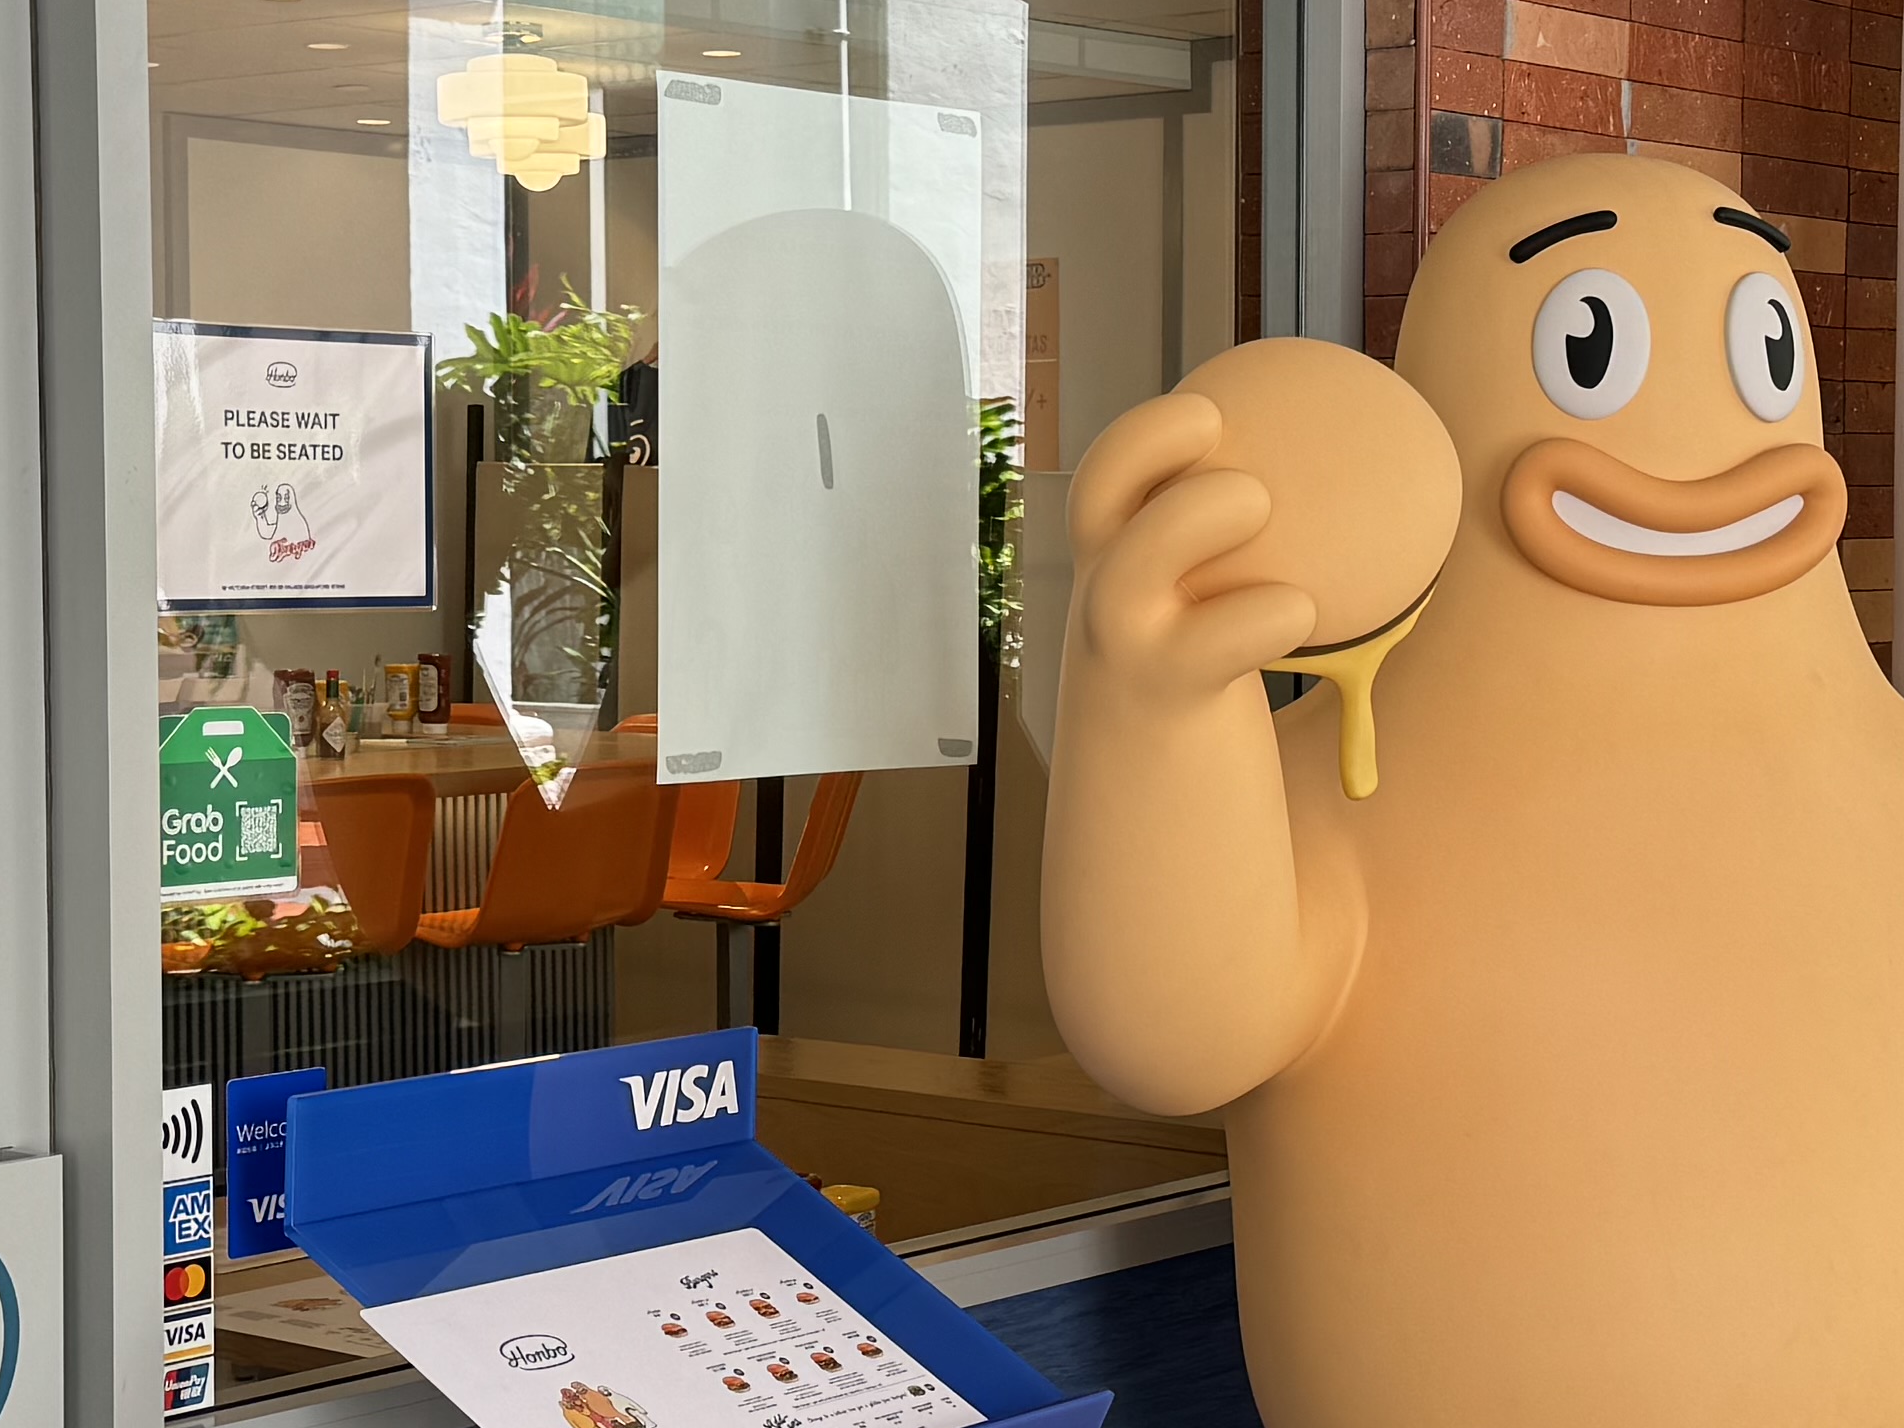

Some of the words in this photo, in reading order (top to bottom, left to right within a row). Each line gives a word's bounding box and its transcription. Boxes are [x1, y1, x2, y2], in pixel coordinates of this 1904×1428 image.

[266, 364, 297, 384] Honbo
[223, 409, 290, 430] PLEASE
[295, 412, 340, 430] WAIT
[221, 441, 245, 460] TO
[250, 442, 272, 460] BE
[276, 443, 344, 462] SEATED
[161, 804, 224, 835] Grab
[162, 834, 223, 866] Food
[619, 1060, 739, 1131] VISA
[236, 1120, 287, 1142] Welco
[247, 1194, 286, 1223] VIS
[166, 1322, 206, 1347] VISA
[507, 1341, 569, 1368] Honbo
